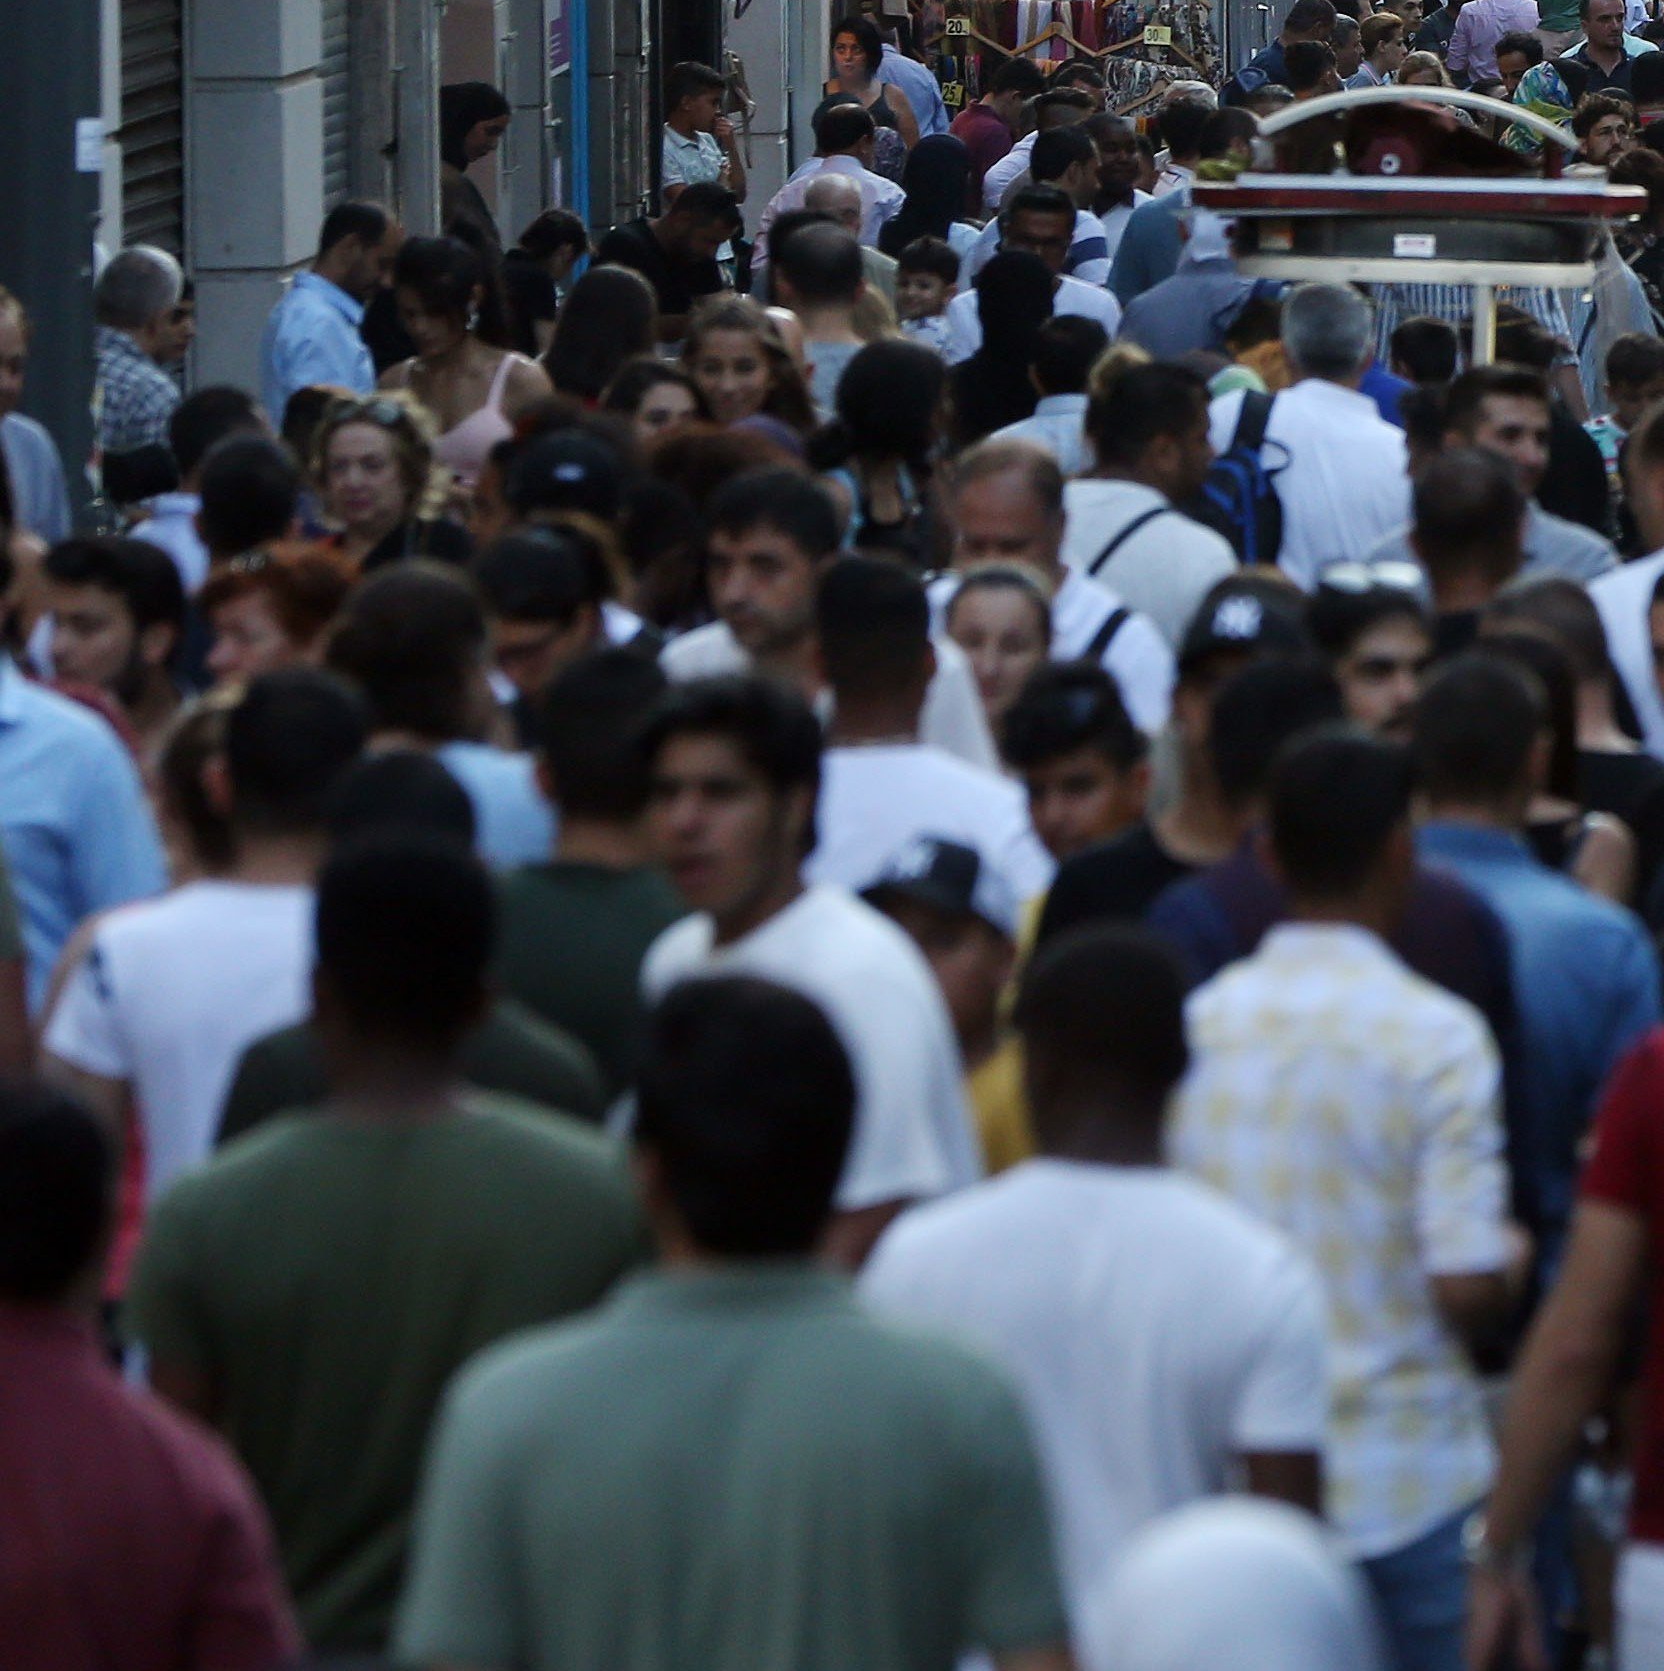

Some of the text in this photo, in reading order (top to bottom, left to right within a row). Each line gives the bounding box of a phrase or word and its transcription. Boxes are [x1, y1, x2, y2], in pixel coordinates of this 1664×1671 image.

[947, 19, 962, 34] 20
[1146, 28, 1159, 42] 30
[943, 85, 956, 102] 25
